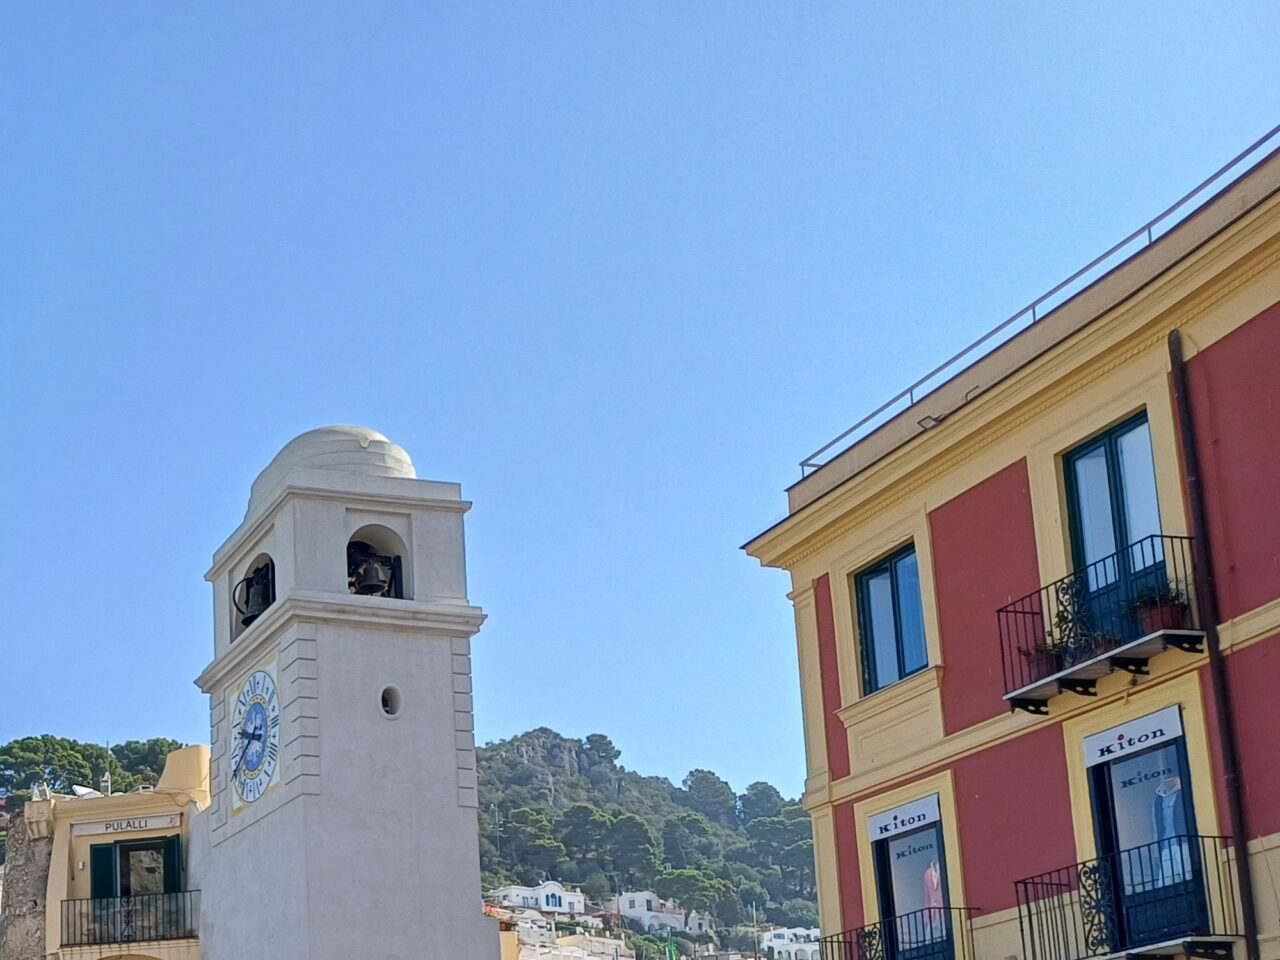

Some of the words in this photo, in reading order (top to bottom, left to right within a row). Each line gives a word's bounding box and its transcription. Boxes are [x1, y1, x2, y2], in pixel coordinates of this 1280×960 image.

[1097, 728, 1166, 758] Kiton
[1120, 768, 1174, 789] Kiton
[104, 819, 148, 832] PULALLI
[878, 813, 926, 834] Kiton
[896, 843, 933, 859] Kiton
